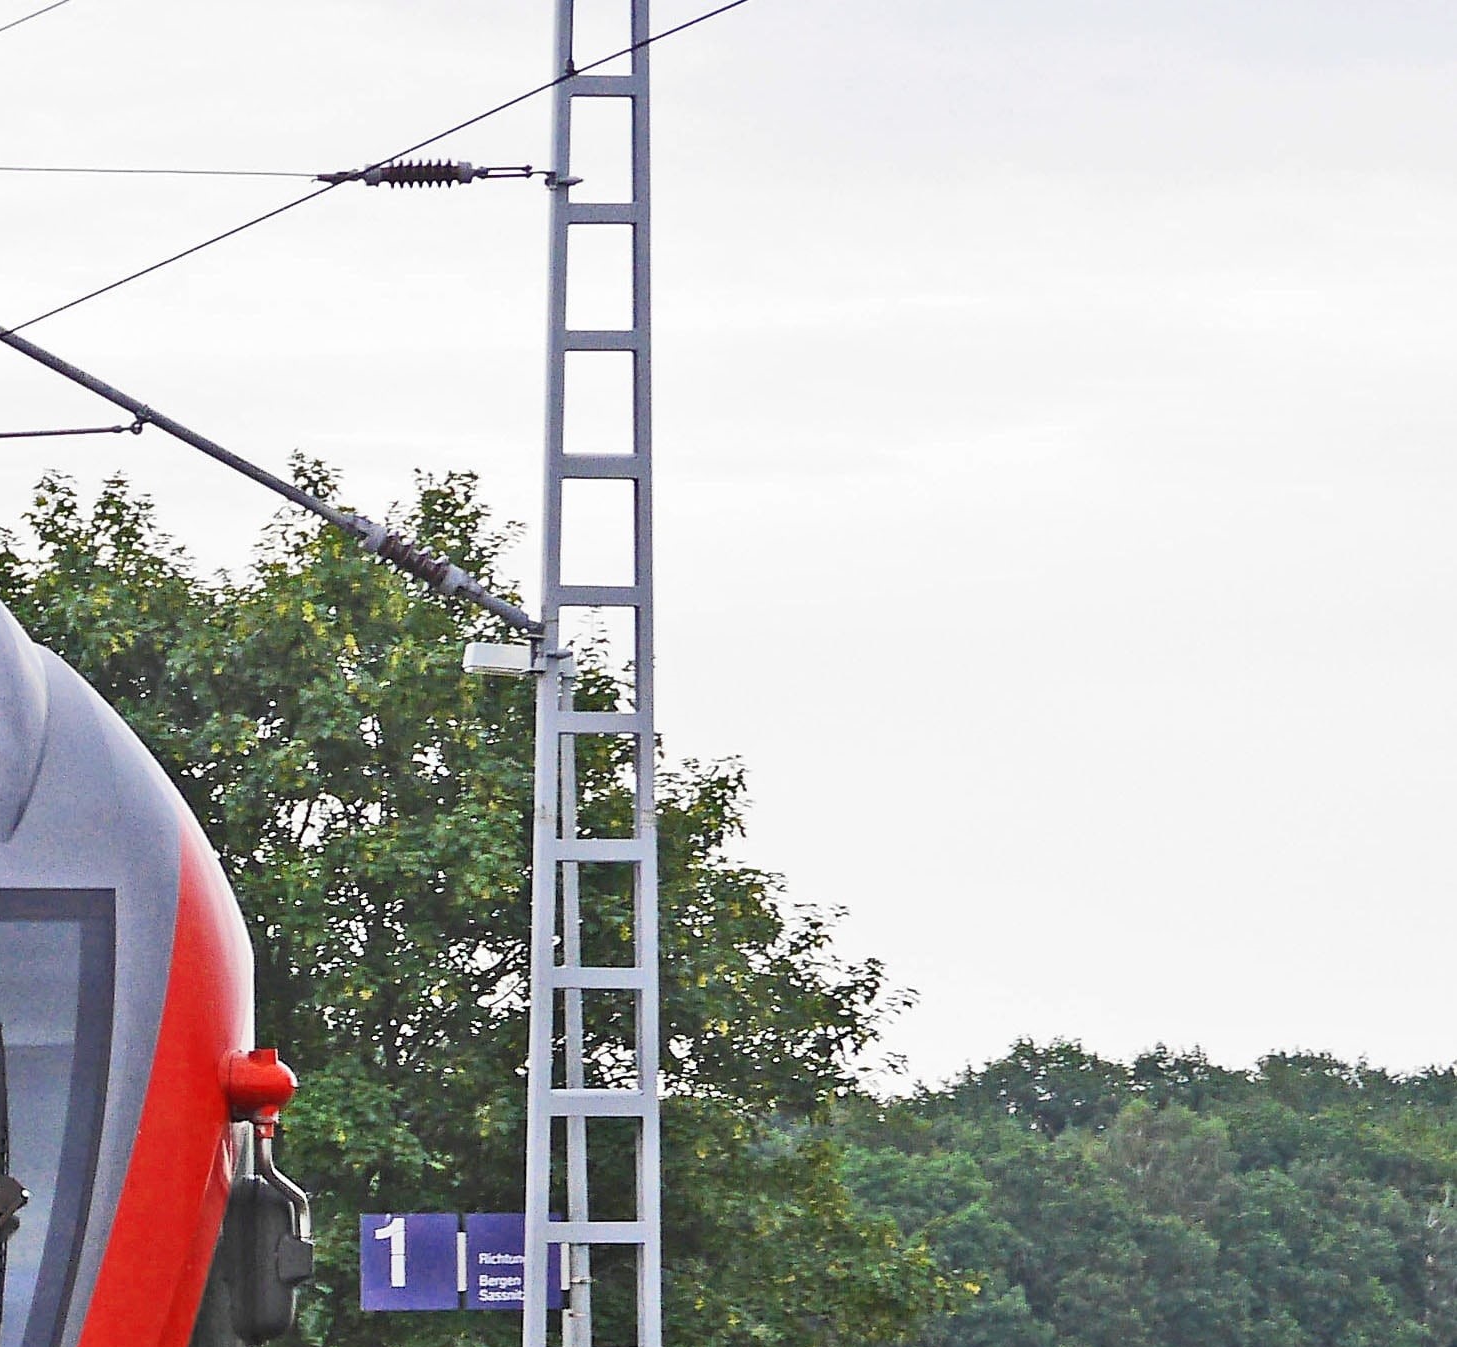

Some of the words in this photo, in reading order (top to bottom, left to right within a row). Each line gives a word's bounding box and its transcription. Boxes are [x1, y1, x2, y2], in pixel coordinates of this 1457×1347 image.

[374, 1217, 407, 1288] 1
[478, 1252, 525, 1265] Richtun
[479, 1274, 522, 1289] Bergen
